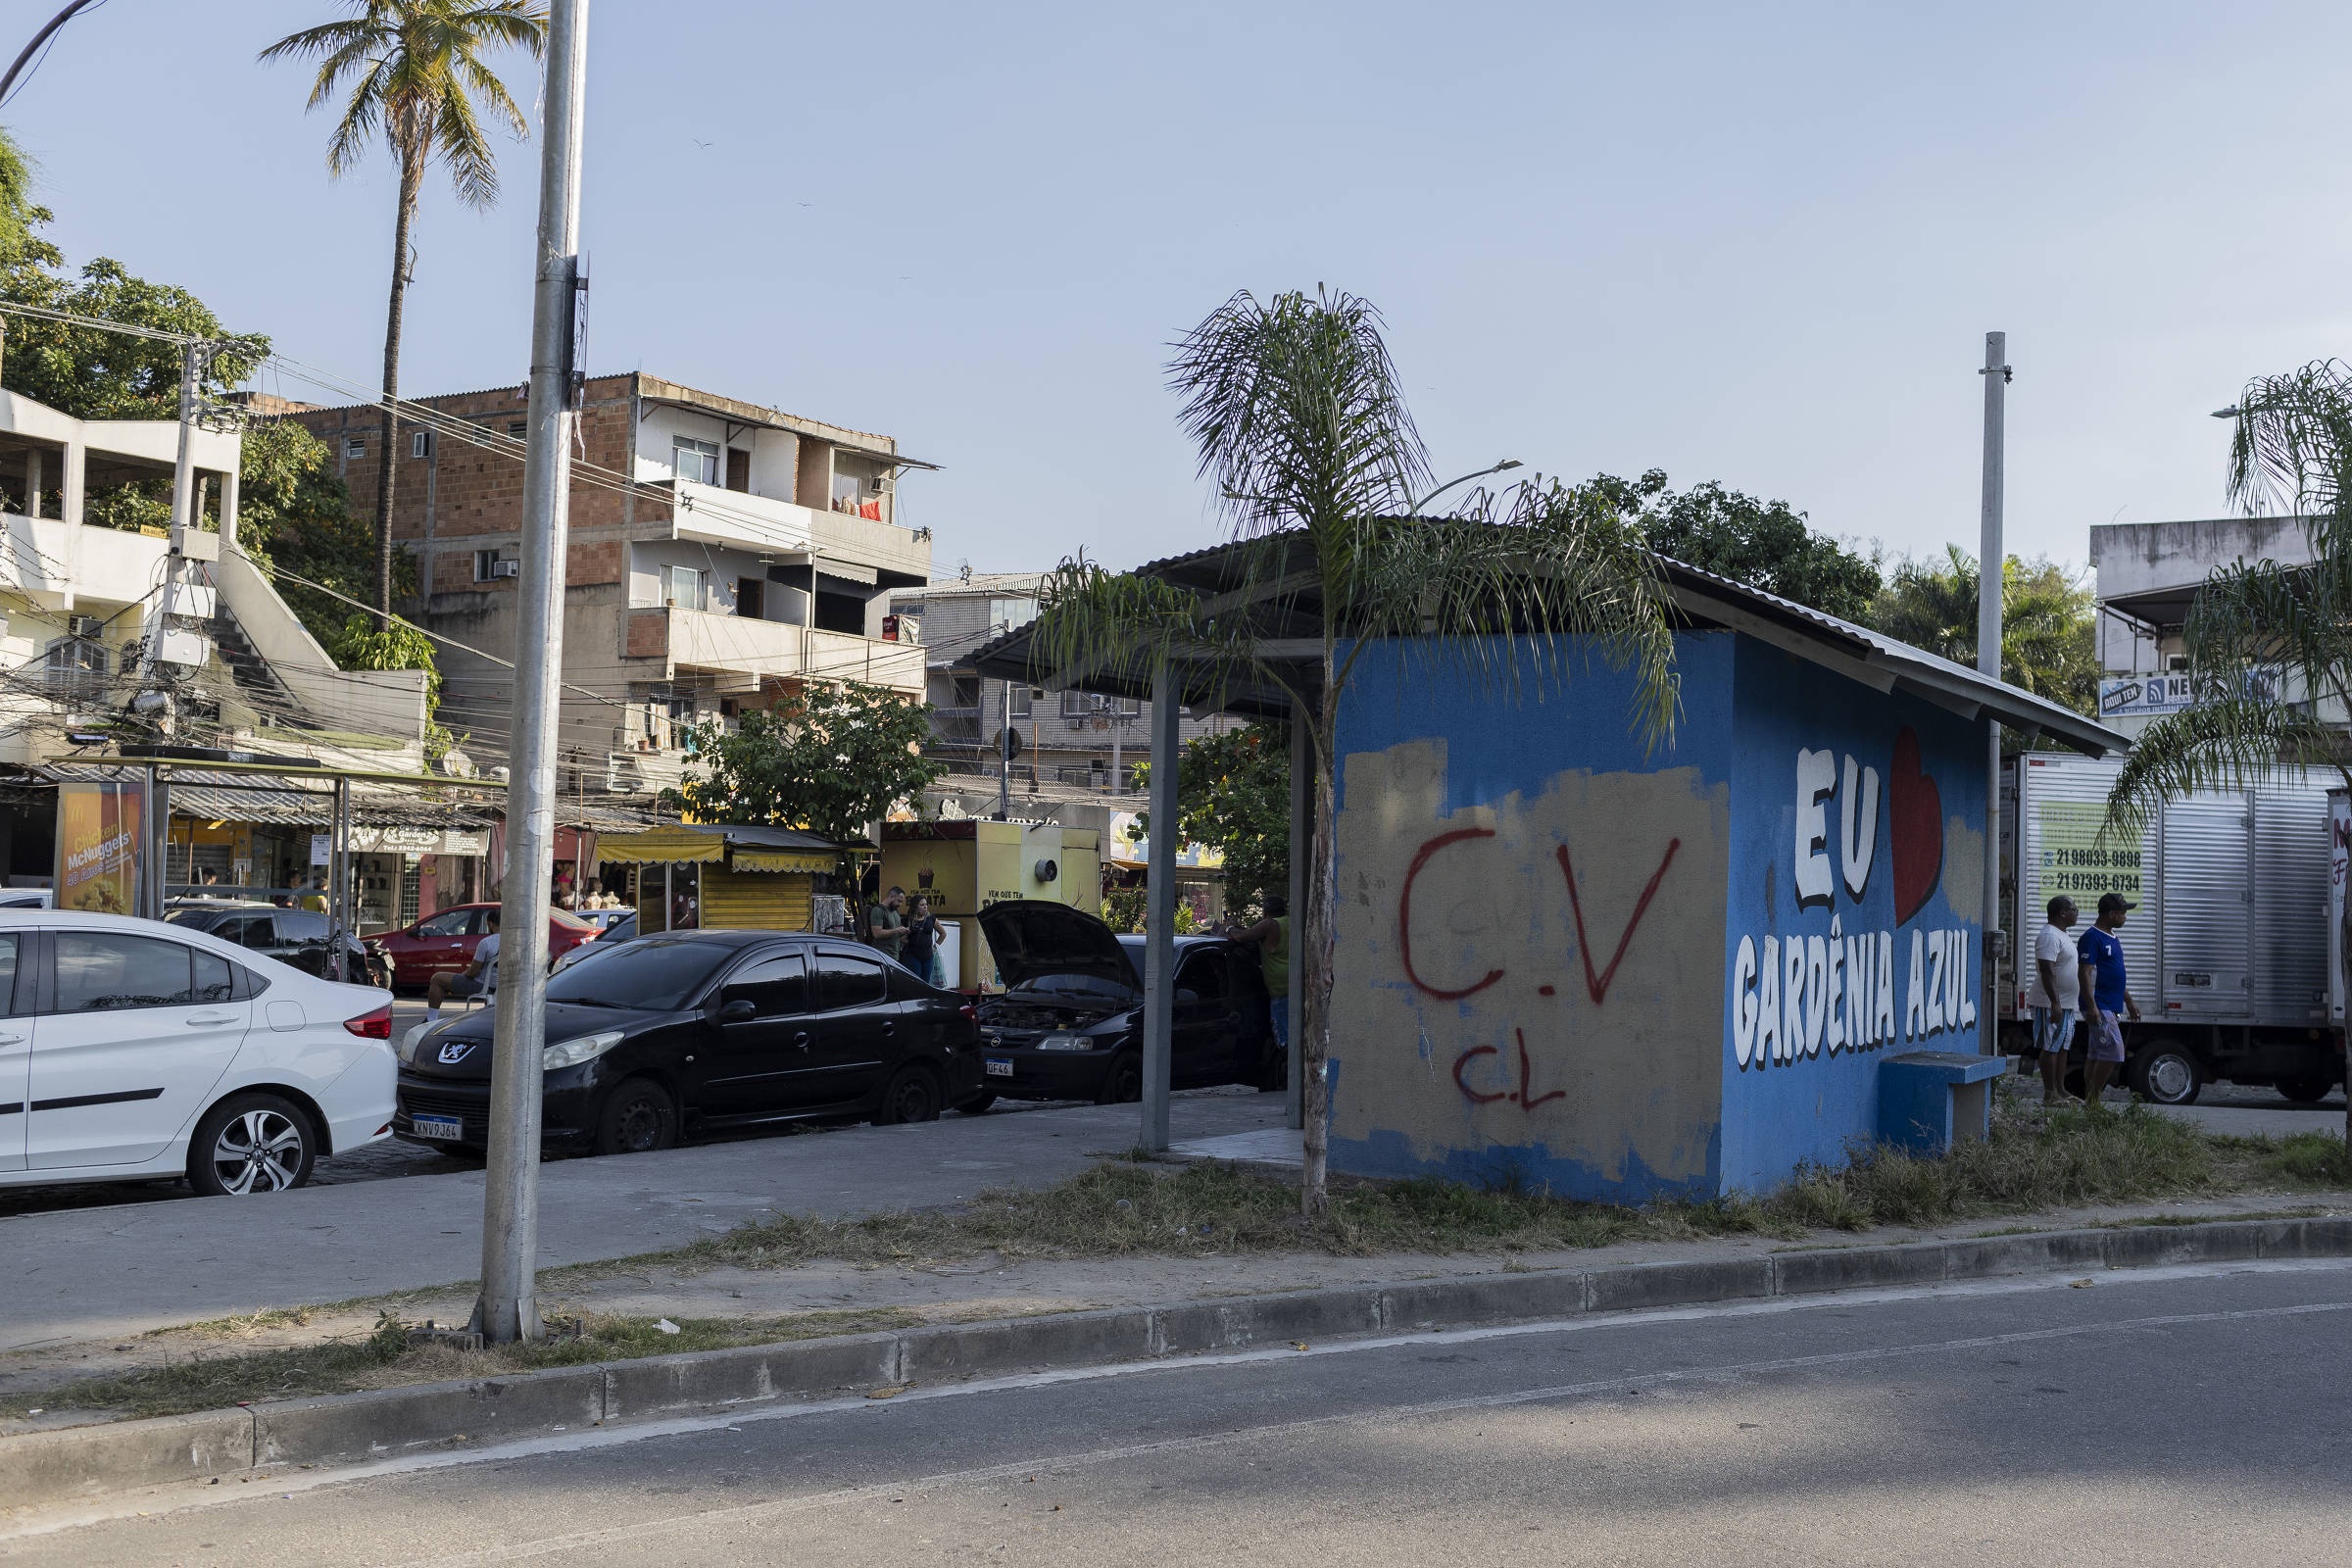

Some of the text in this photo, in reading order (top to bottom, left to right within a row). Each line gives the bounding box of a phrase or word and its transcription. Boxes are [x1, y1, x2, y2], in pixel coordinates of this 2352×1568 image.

[2104, 686, 2138, 710] AQUI TEM
[2124, 706, 2151, 714] MELHOR
[74, 823, 119, 853] Chicken
[1794, 747, 1882, 914] EU
[68, 832, 129, 871] McNuggets
[2057, 849, 2141, 868] 21 98033-9898
[67, 870, 79, 886] 40
[2057, 872, 2140, 892] 21 97393-6734
[906, 895, 946, 907] BATA
[2105, 945, 2112, 956] 7
[1733, 912, 1977, 1071] GARDÊNIA AZUL
